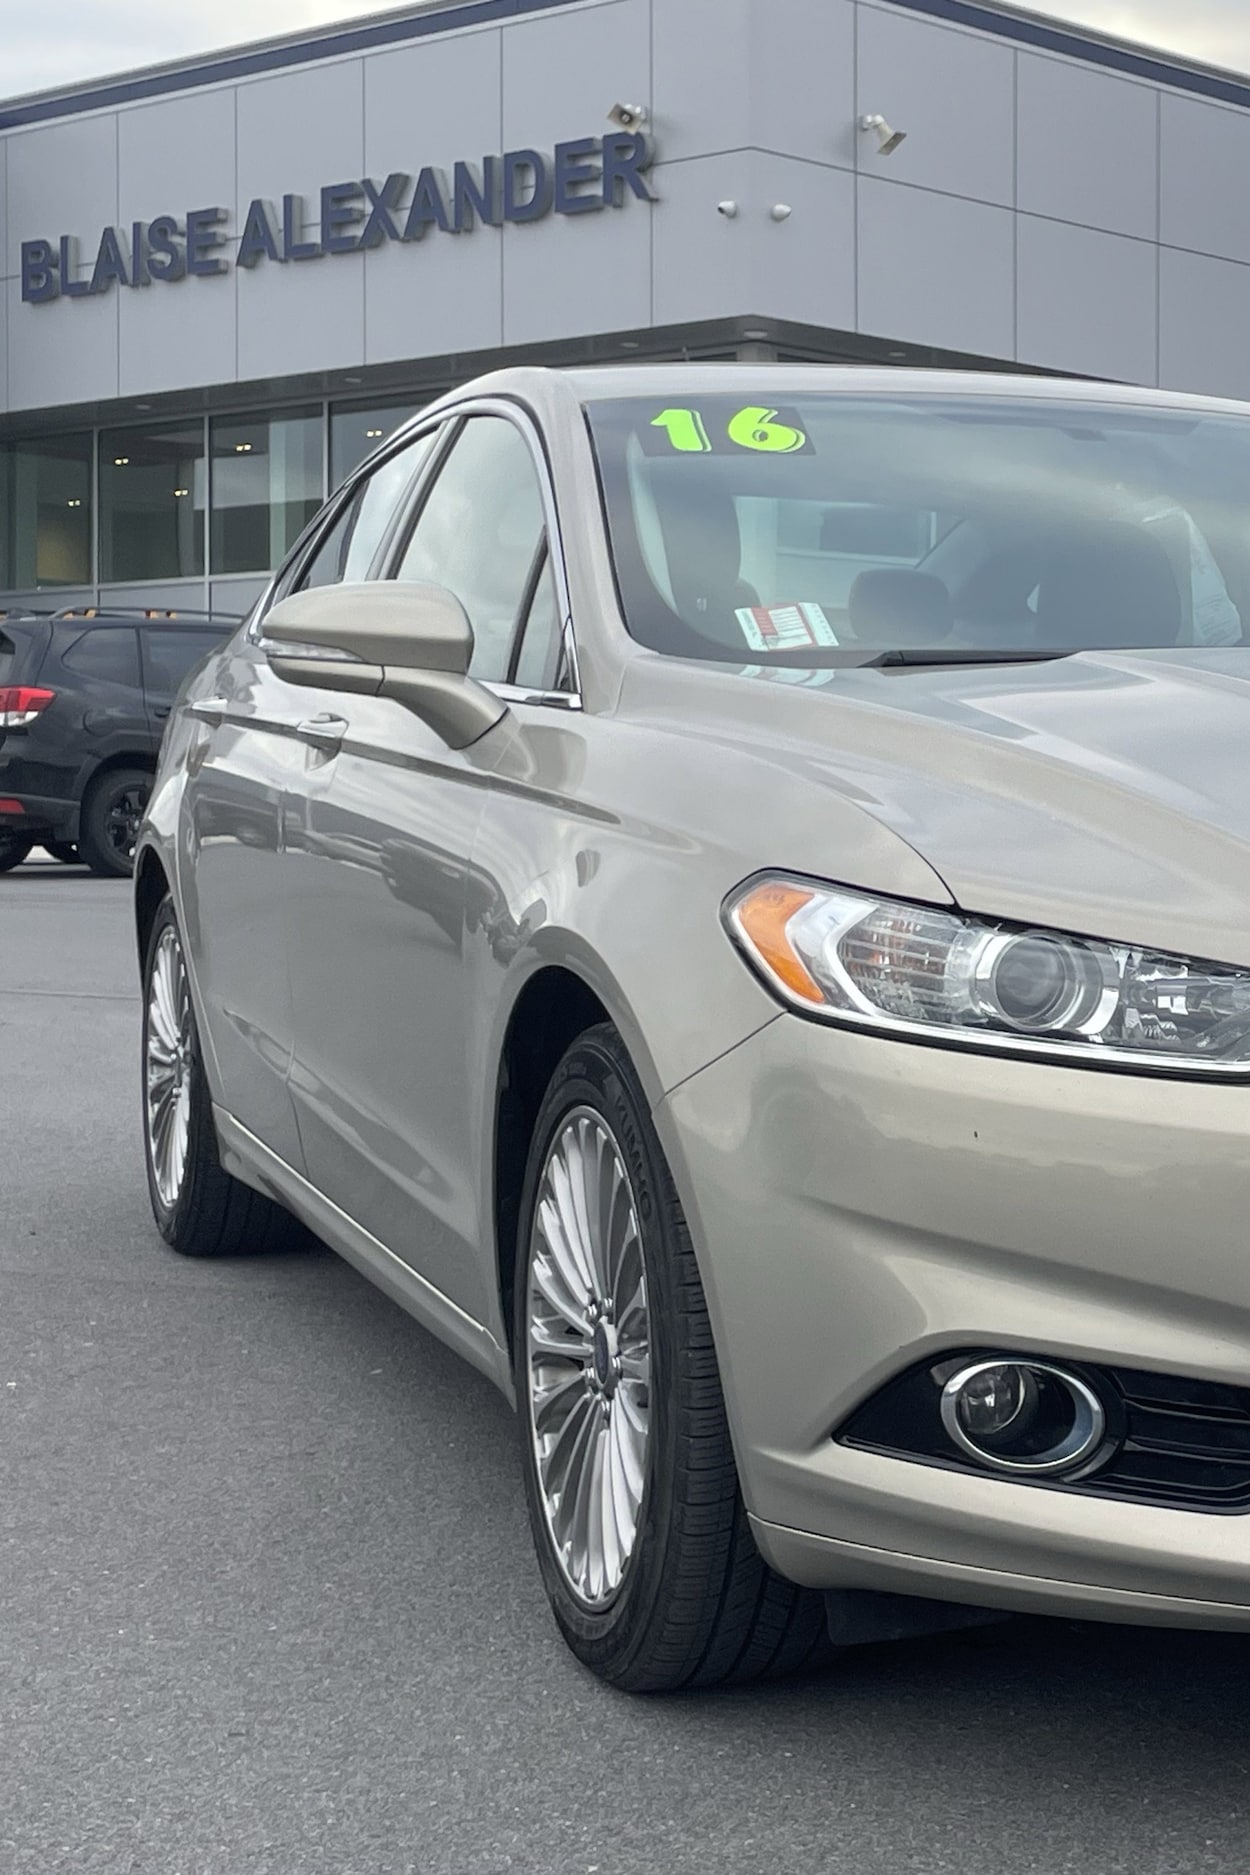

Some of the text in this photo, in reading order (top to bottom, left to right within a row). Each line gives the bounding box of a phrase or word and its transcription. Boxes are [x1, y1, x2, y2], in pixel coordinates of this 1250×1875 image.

[21, 131, 660, 304] BLAISE ALEXANDER
[650, 406, 807, 453] 16
